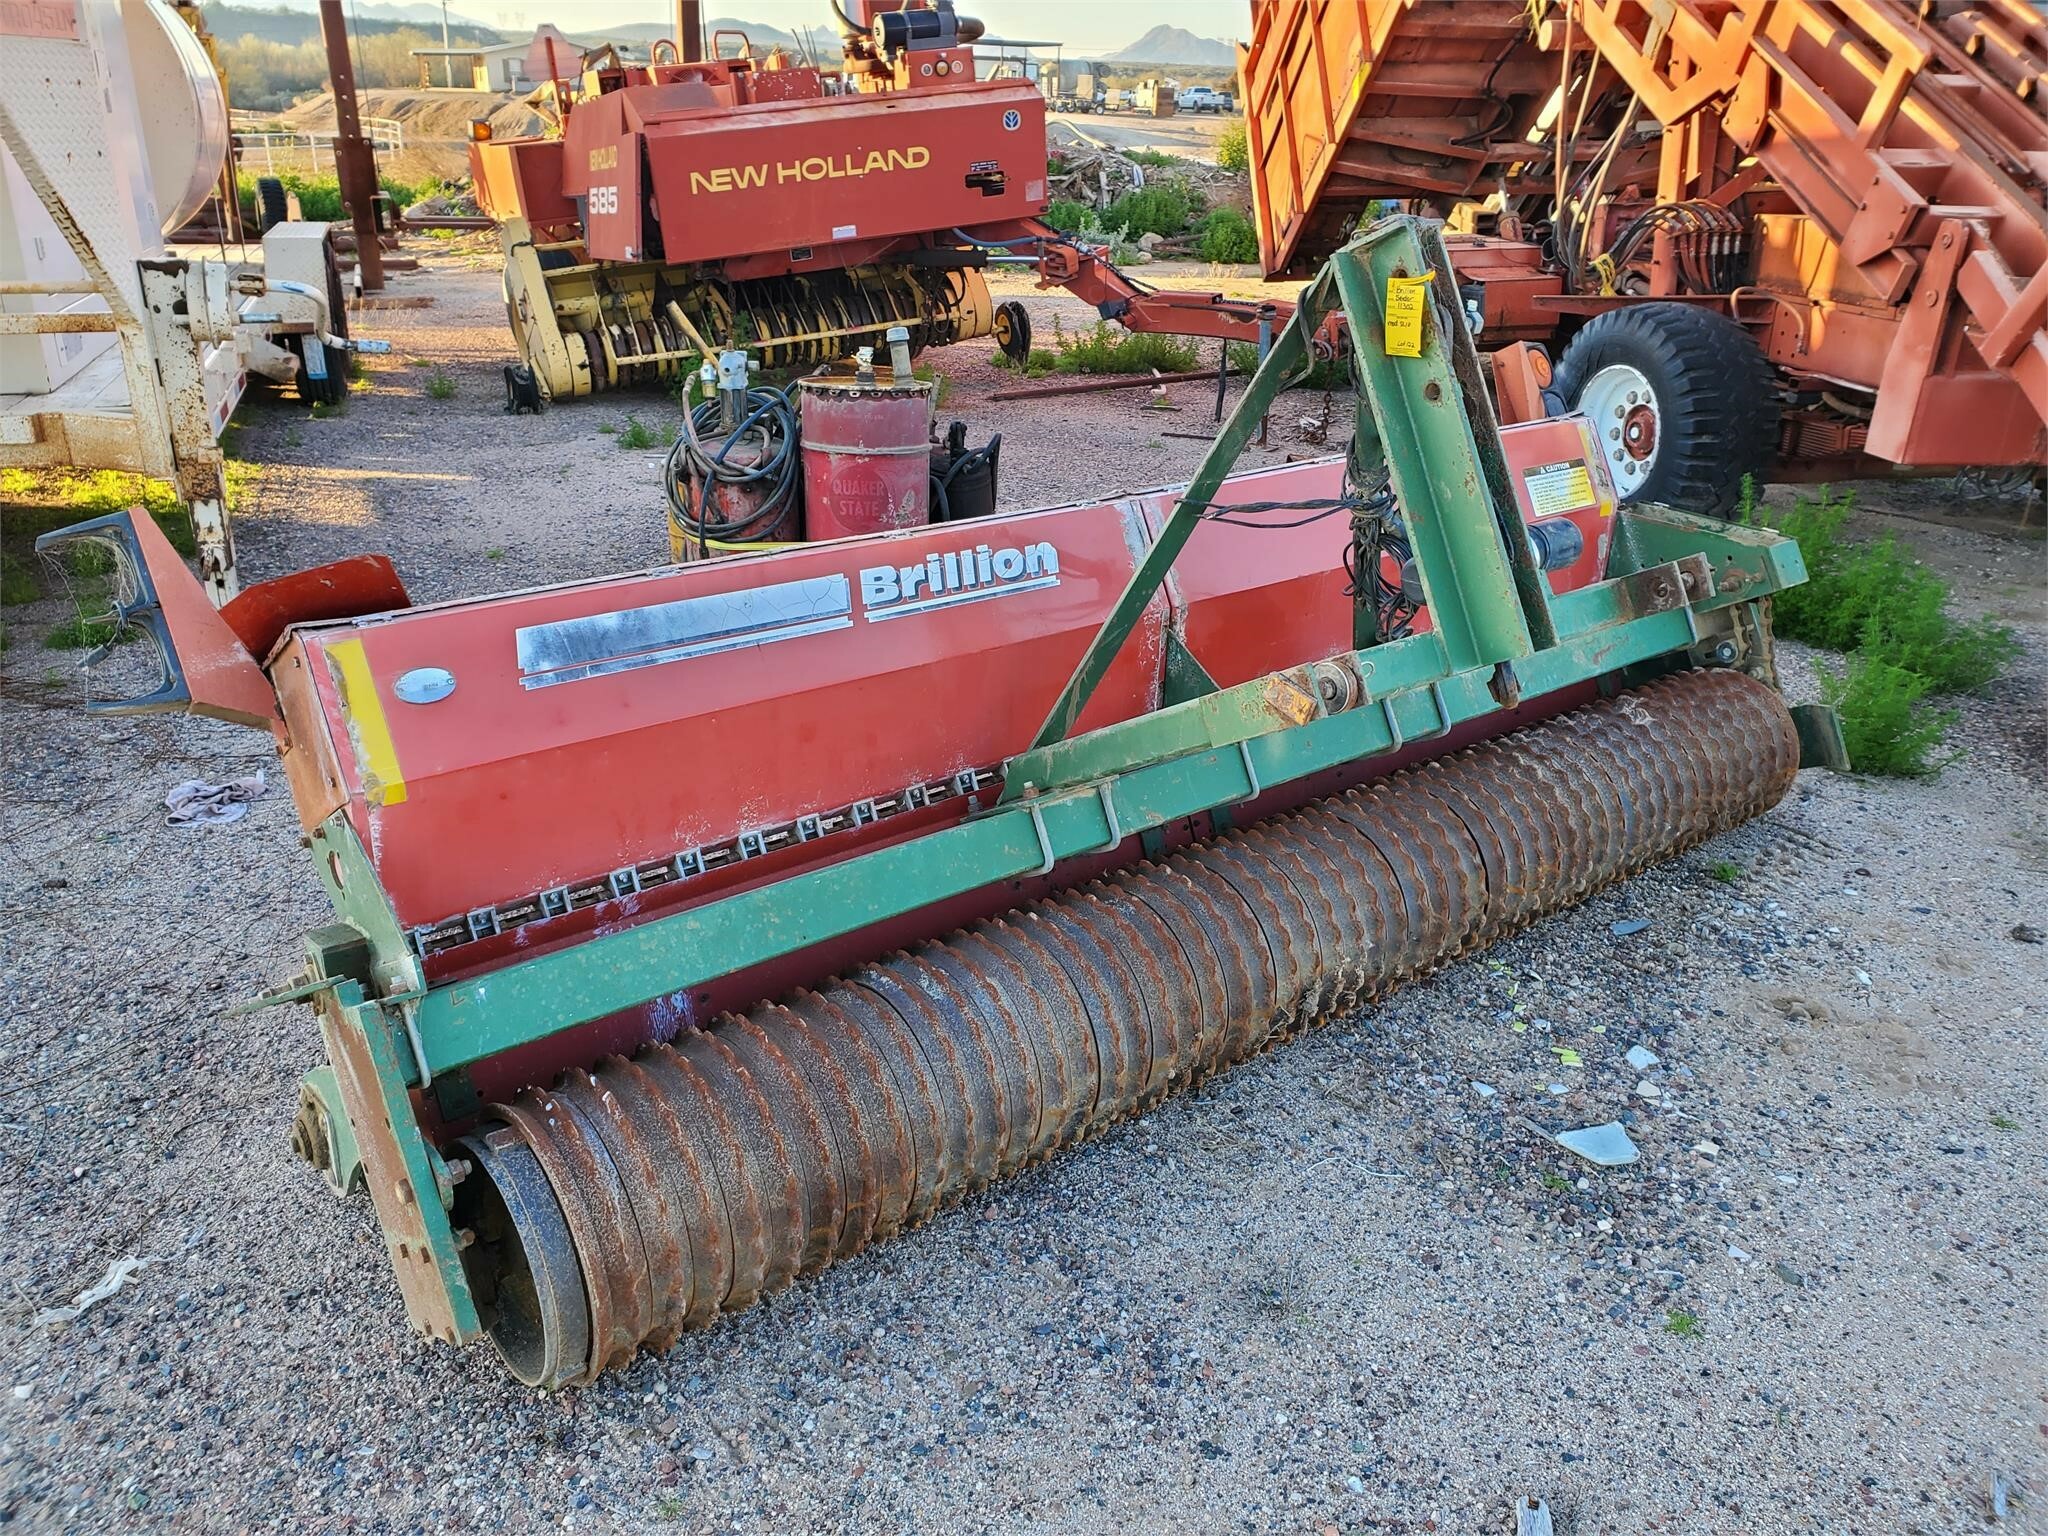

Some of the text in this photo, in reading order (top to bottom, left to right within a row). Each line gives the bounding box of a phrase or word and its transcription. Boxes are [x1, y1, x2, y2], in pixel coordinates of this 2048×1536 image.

[689, 146, 930, 195] NEW HOLLAND
[588, 185, 619, 215] 585
[1545, 462, 1571, 473] CAUTION
[832, 479, 885, 497] QUAKER
[839, 500, 879, 517] STATE
[859, 541, 1060, 610] Brillion
